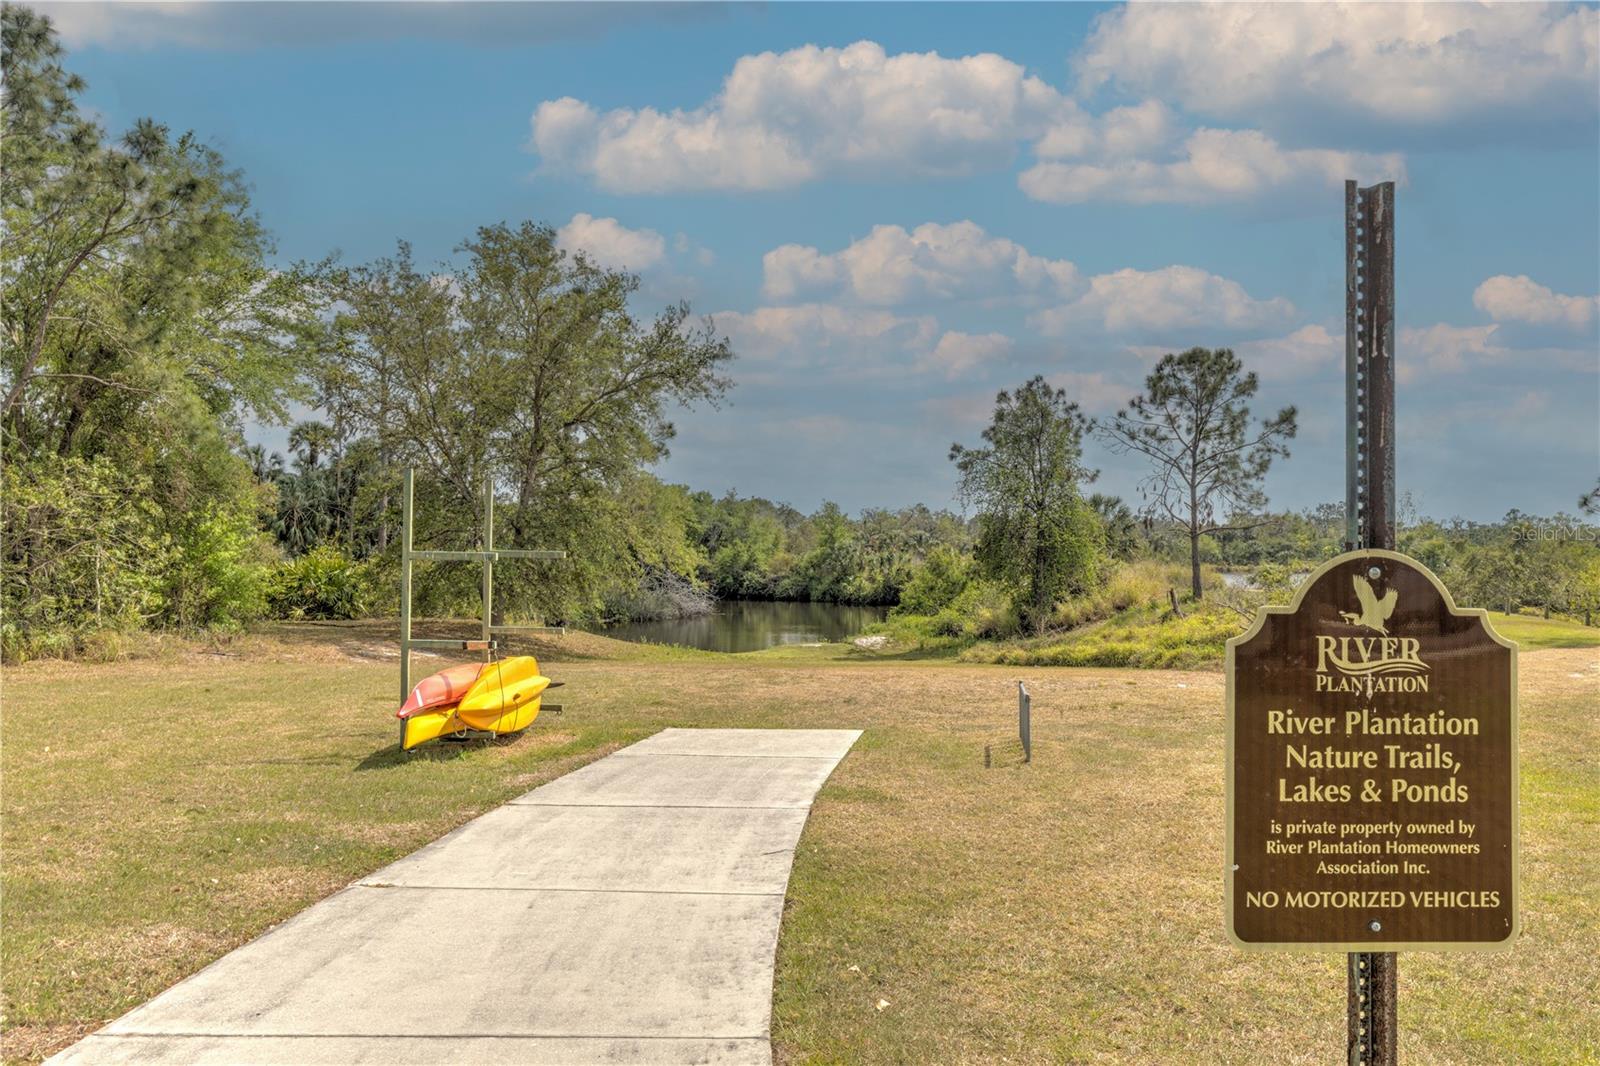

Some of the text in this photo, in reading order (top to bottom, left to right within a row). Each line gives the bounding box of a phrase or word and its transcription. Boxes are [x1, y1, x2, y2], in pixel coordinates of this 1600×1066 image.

[1315, 634, 1425, 672] RIVER
[1315, 674, 1429, 692] PLANTATION
[1268, 709, 1478, 735] River Plantation
[1287, 743, 1461, 774] Nature Trails,
[1280, 777, 1468, 802] Lakes & Ponds
[1271, 820, 1475, 838] is private property owned by
[1267, 840, 1480, 854] River Plantation Homeowners
[1317, 860, 1430, 874] Association Inc.
[1247, 891, 1500, 908] NO MOTORIZED VEHICLES
